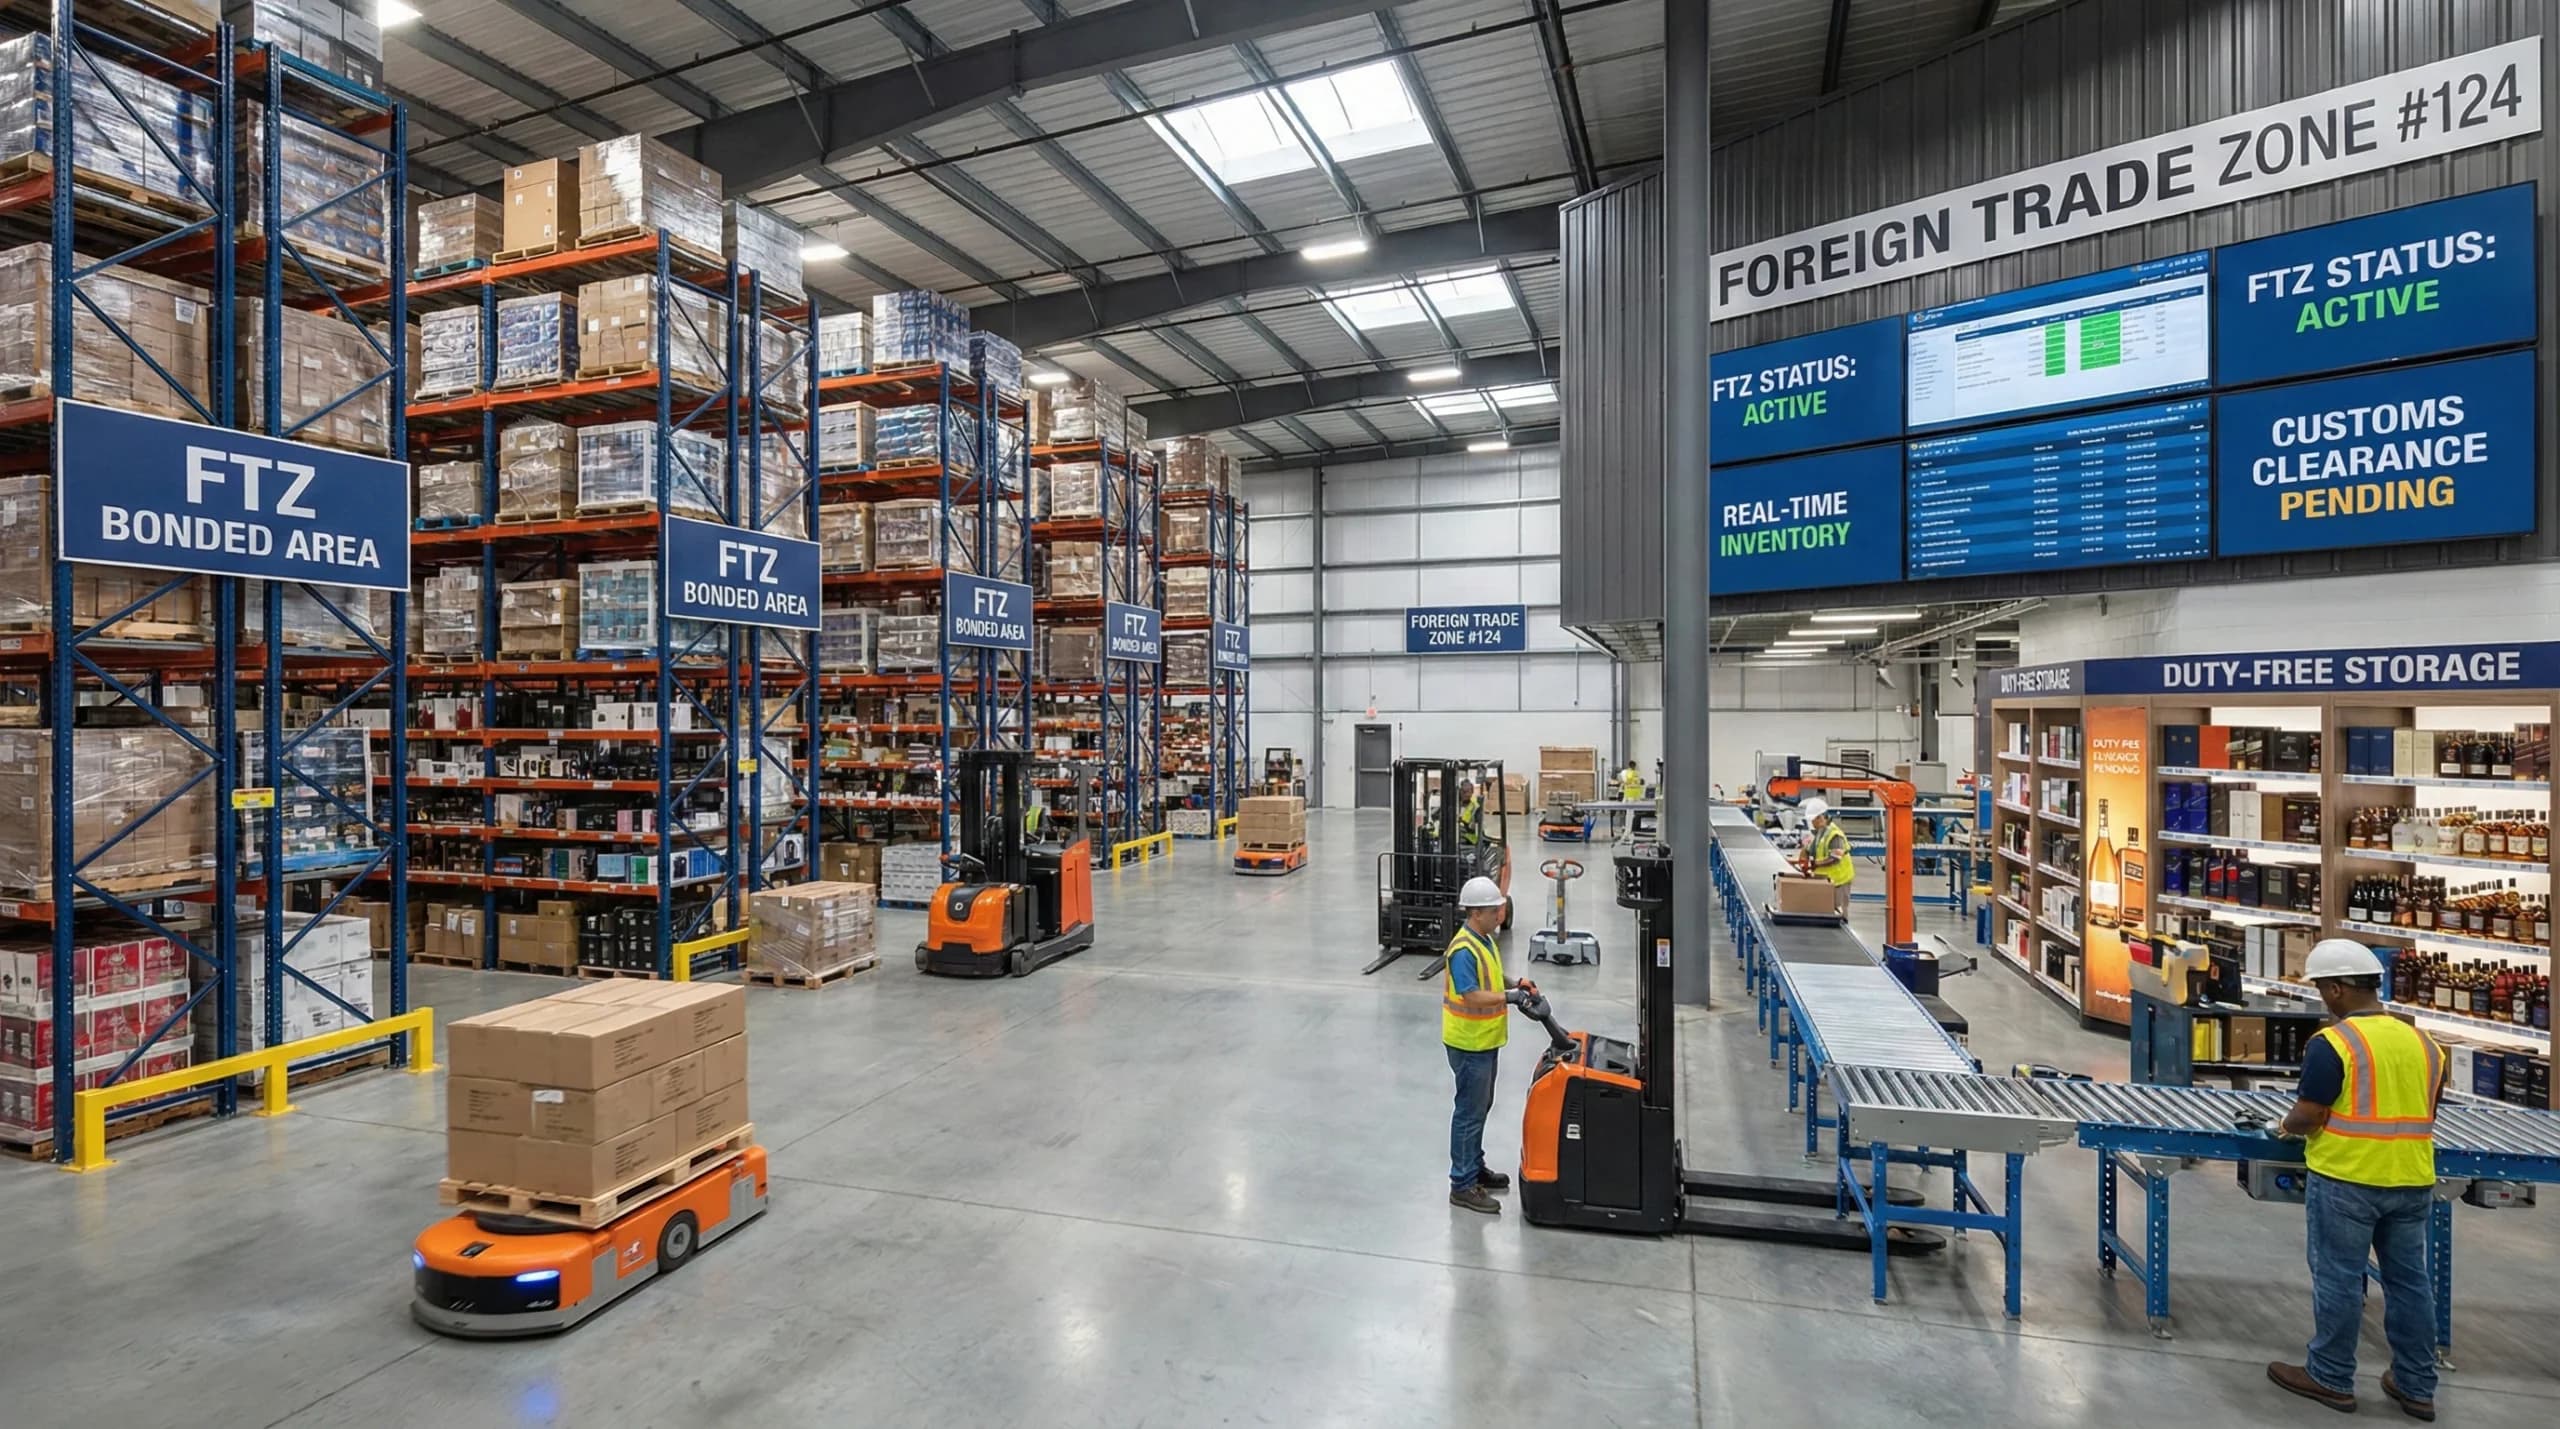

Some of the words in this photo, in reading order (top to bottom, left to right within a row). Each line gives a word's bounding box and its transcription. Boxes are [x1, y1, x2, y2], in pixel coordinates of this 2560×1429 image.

[1718, 207, 1951, 306] FOREIGN
[1972, 144, 2195, 243] TRADE
[2218, 98, 2379, 187] ZONE
[2398, 63, 2523, 143] #124
[2248, 263, 2314, 304] FTZ
[2327, 231, 2497, 289] STATUS:
[2296, 278, 2441, 334] ACTIVE
[1712, 373, 1753, 402] FTZ
[1759, 354, 1857, 393] STATUS:
[1742, 390, 1827, 427] ACTIVE
[2272, 395, 2465, 448] CUSTOMS
[2252, 433, 2488, 488] CLEARANCE
[185, 445, 316, 520] FTZ
[2280, 475, 2456, 521] PENDING
[1723, 491, 1848, 528] REAL-TIME
[101, 505, 273, 558] BONDED
[285, 530, 380, 570] AREA
[1720, 521, 1851, 557] INVENTORY
[718, 539, 779, 586] FTZ
[683, 579, 758, 611] BONDED
[764, 588, 809, 617] AREA
[974, 586, 1009, 618] FTZ
[955, 616, 999, 638] BONDED
[1124, 612, 1148, 637] FTZ
[1225, 629, 1241, 649] FTZ
[1411, 613, 1469, 629] FOREIGN
[1473, 612, 1519, 627] TRADE
[1428, 630, 1465, 645] ZONE
[1468, 629, 1502, 645] #124
[2163, 657, 2334, 688] DUTY-FREE
[2344, 651, 2522, 685] STORAGE
[2092, 738, 2120, 749] DUTY
